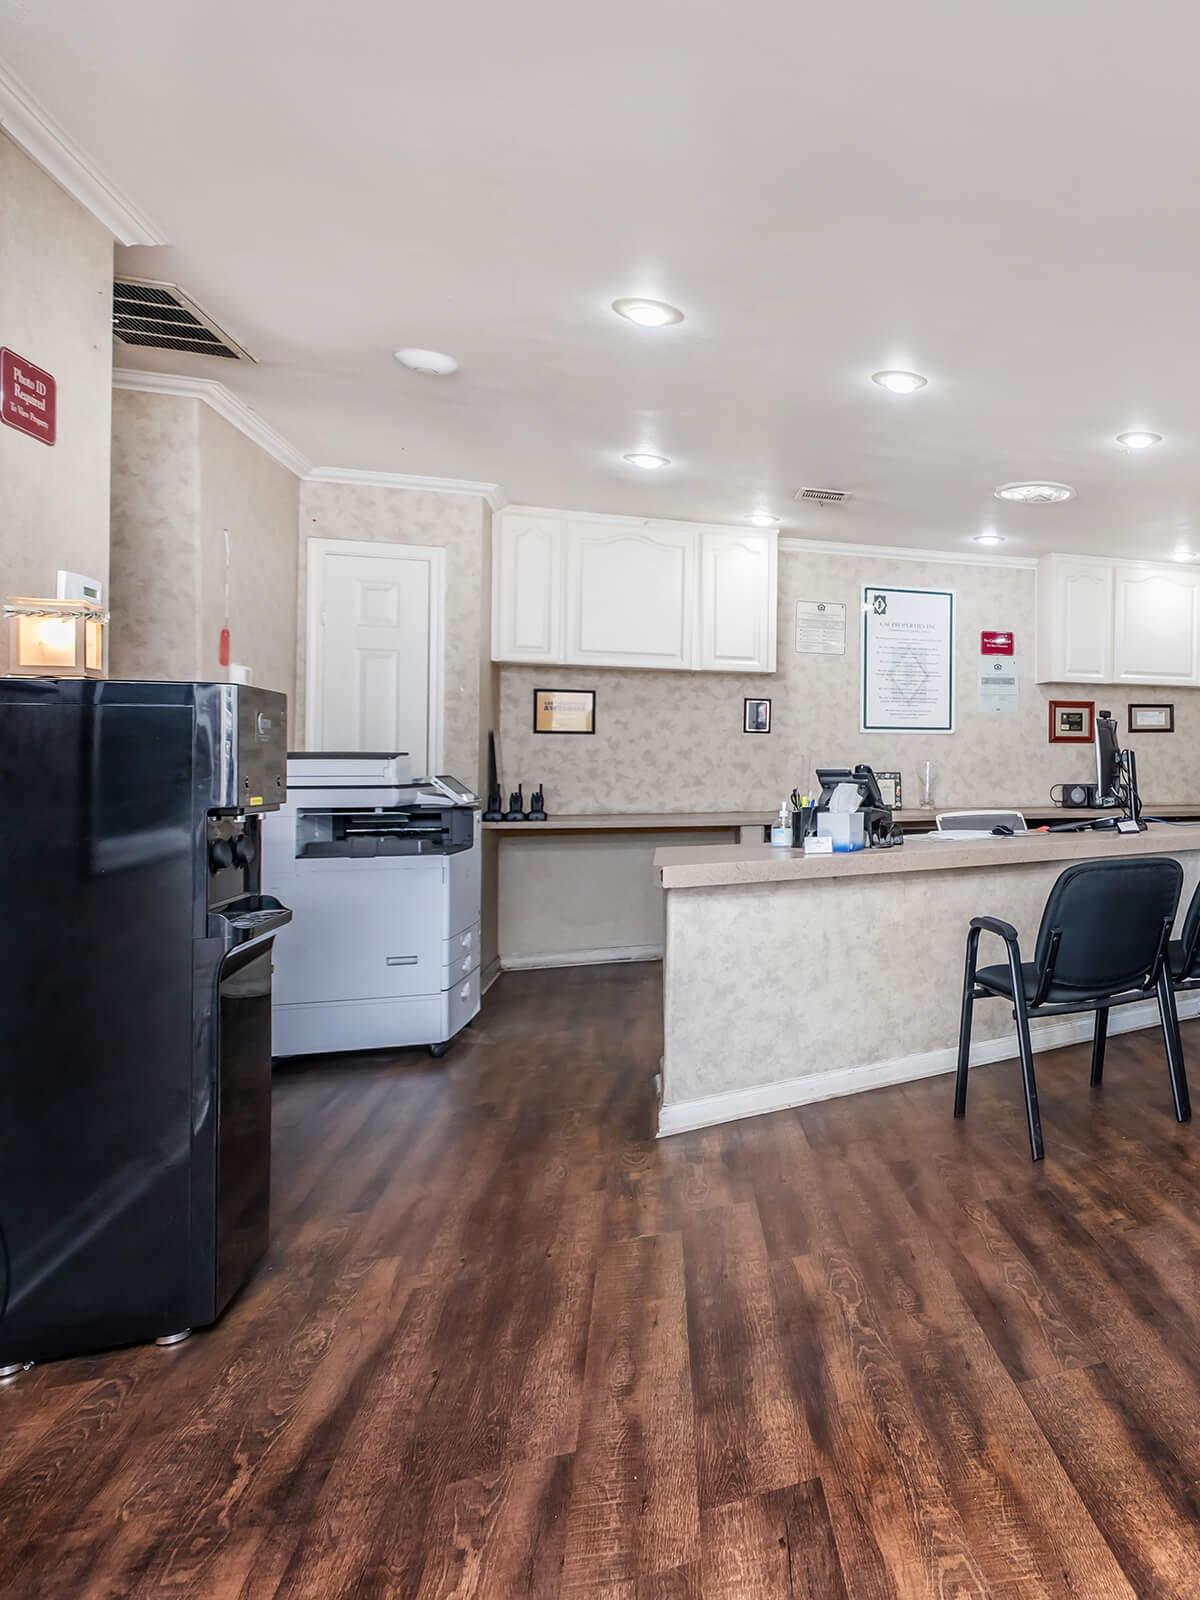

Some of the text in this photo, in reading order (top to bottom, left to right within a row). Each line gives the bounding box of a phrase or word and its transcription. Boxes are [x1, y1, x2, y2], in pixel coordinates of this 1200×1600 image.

[13, 367, 47, 396] Photo ID
[14, 382, 46, 411] Required
